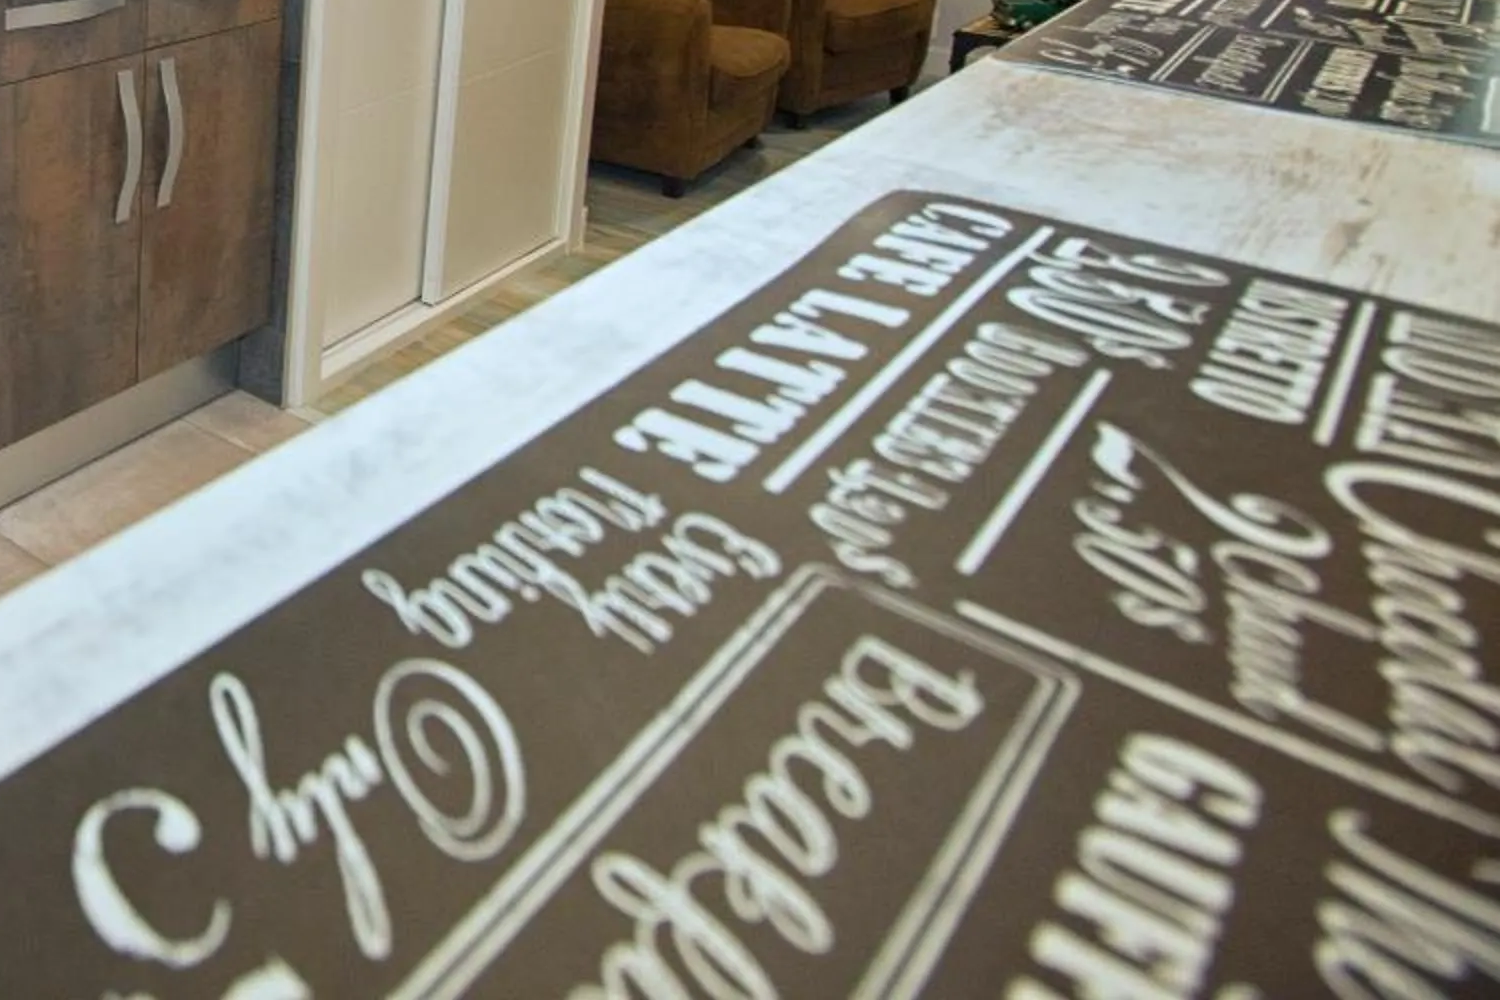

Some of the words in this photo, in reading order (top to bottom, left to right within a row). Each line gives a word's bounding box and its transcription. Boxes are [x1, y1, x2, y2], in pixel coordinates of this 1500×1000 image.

[837, 202, 1014, 297] CAFE
[611, 287, 911, 484] LATTE
[872, 321, 1090, 483] COOKIES
[1188, 277, 1349, 425] RISTRETTO
[361, 466, 667, 648] Morning
[542, 511, 783, 657] Every
[209, 657, 526, 960] Only
